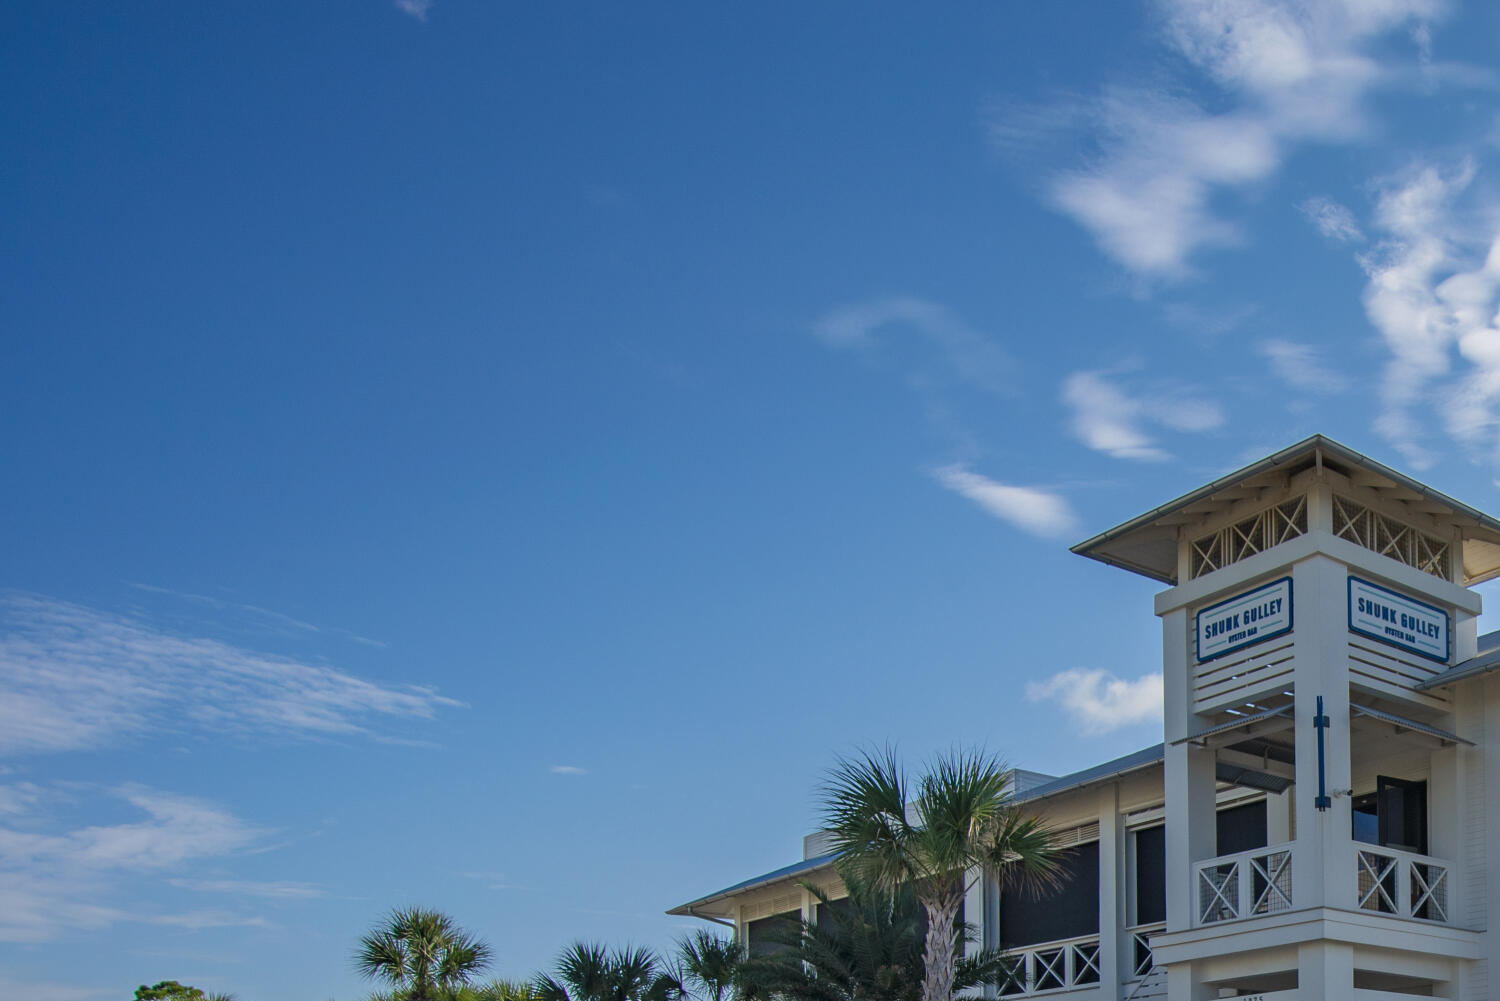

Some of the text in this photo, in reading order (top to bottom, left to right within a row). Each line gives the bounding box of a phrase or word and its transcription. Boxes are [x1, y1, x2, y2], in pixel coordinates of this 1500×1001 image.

[1205, 598, 1282, 640] SHUNK GULLEY
[1358, 597, 1440, 640] SHUNK GULLEY
[1228, 626, 1258, 643] OYSTER BAR
[1384, 626, 1416, 644] OYSTER BAR
